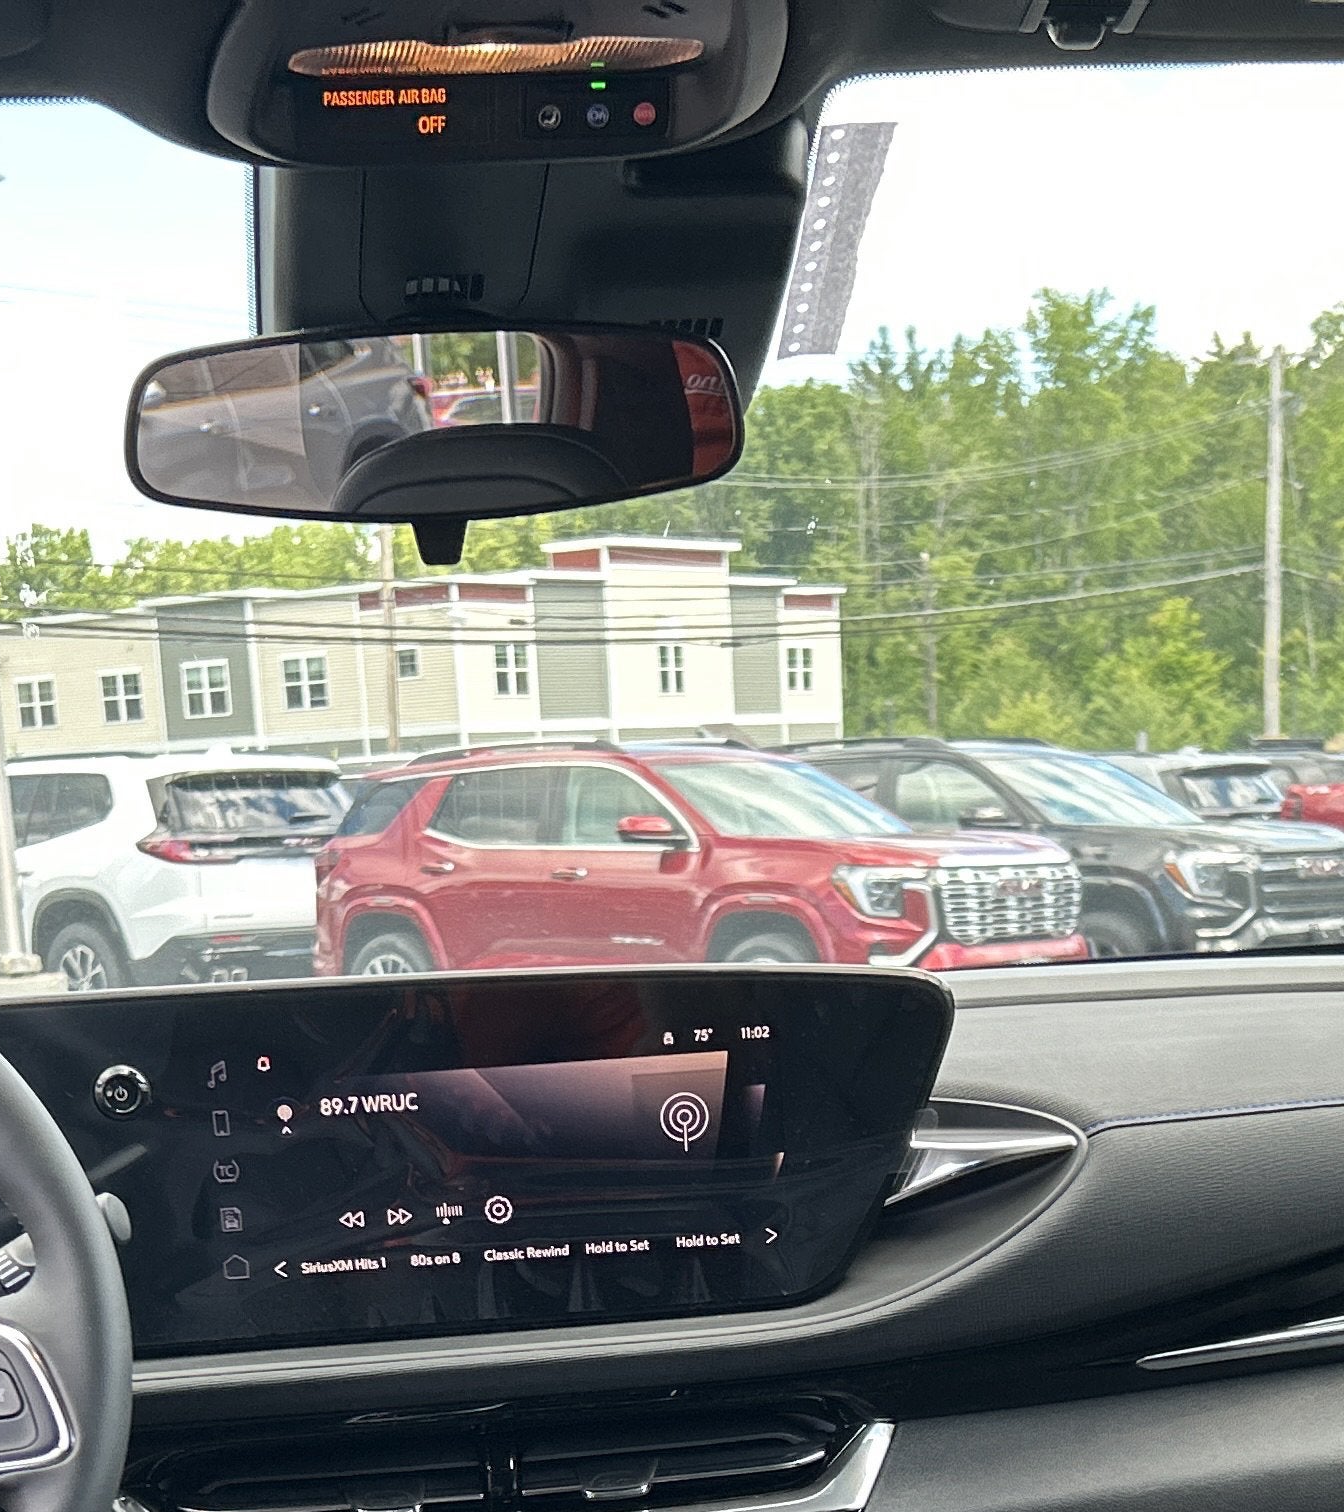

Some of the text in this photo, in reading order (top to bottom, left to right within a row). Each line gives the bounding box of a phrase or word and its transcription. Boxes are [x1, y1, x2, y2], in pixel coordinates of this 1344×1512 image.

[323, 88, 446, 106] PASSENGER AIR BAG
[418, 115, 446, 134] OFF
[740, 1026, 770, 1040] 11:02
[320, 1092, 418, 1116] 89.7 WRUC
[585, 1239, 650, 1255] Hold to Set
[676, 1232, 740, 1248] Hold to Set
[410, 1252, 461, 1267] 80s on 8
[484, 1244, 570, 1262] Classic Rewind
[301, 1257, 387, 1275] SiriusXM Hits 1
